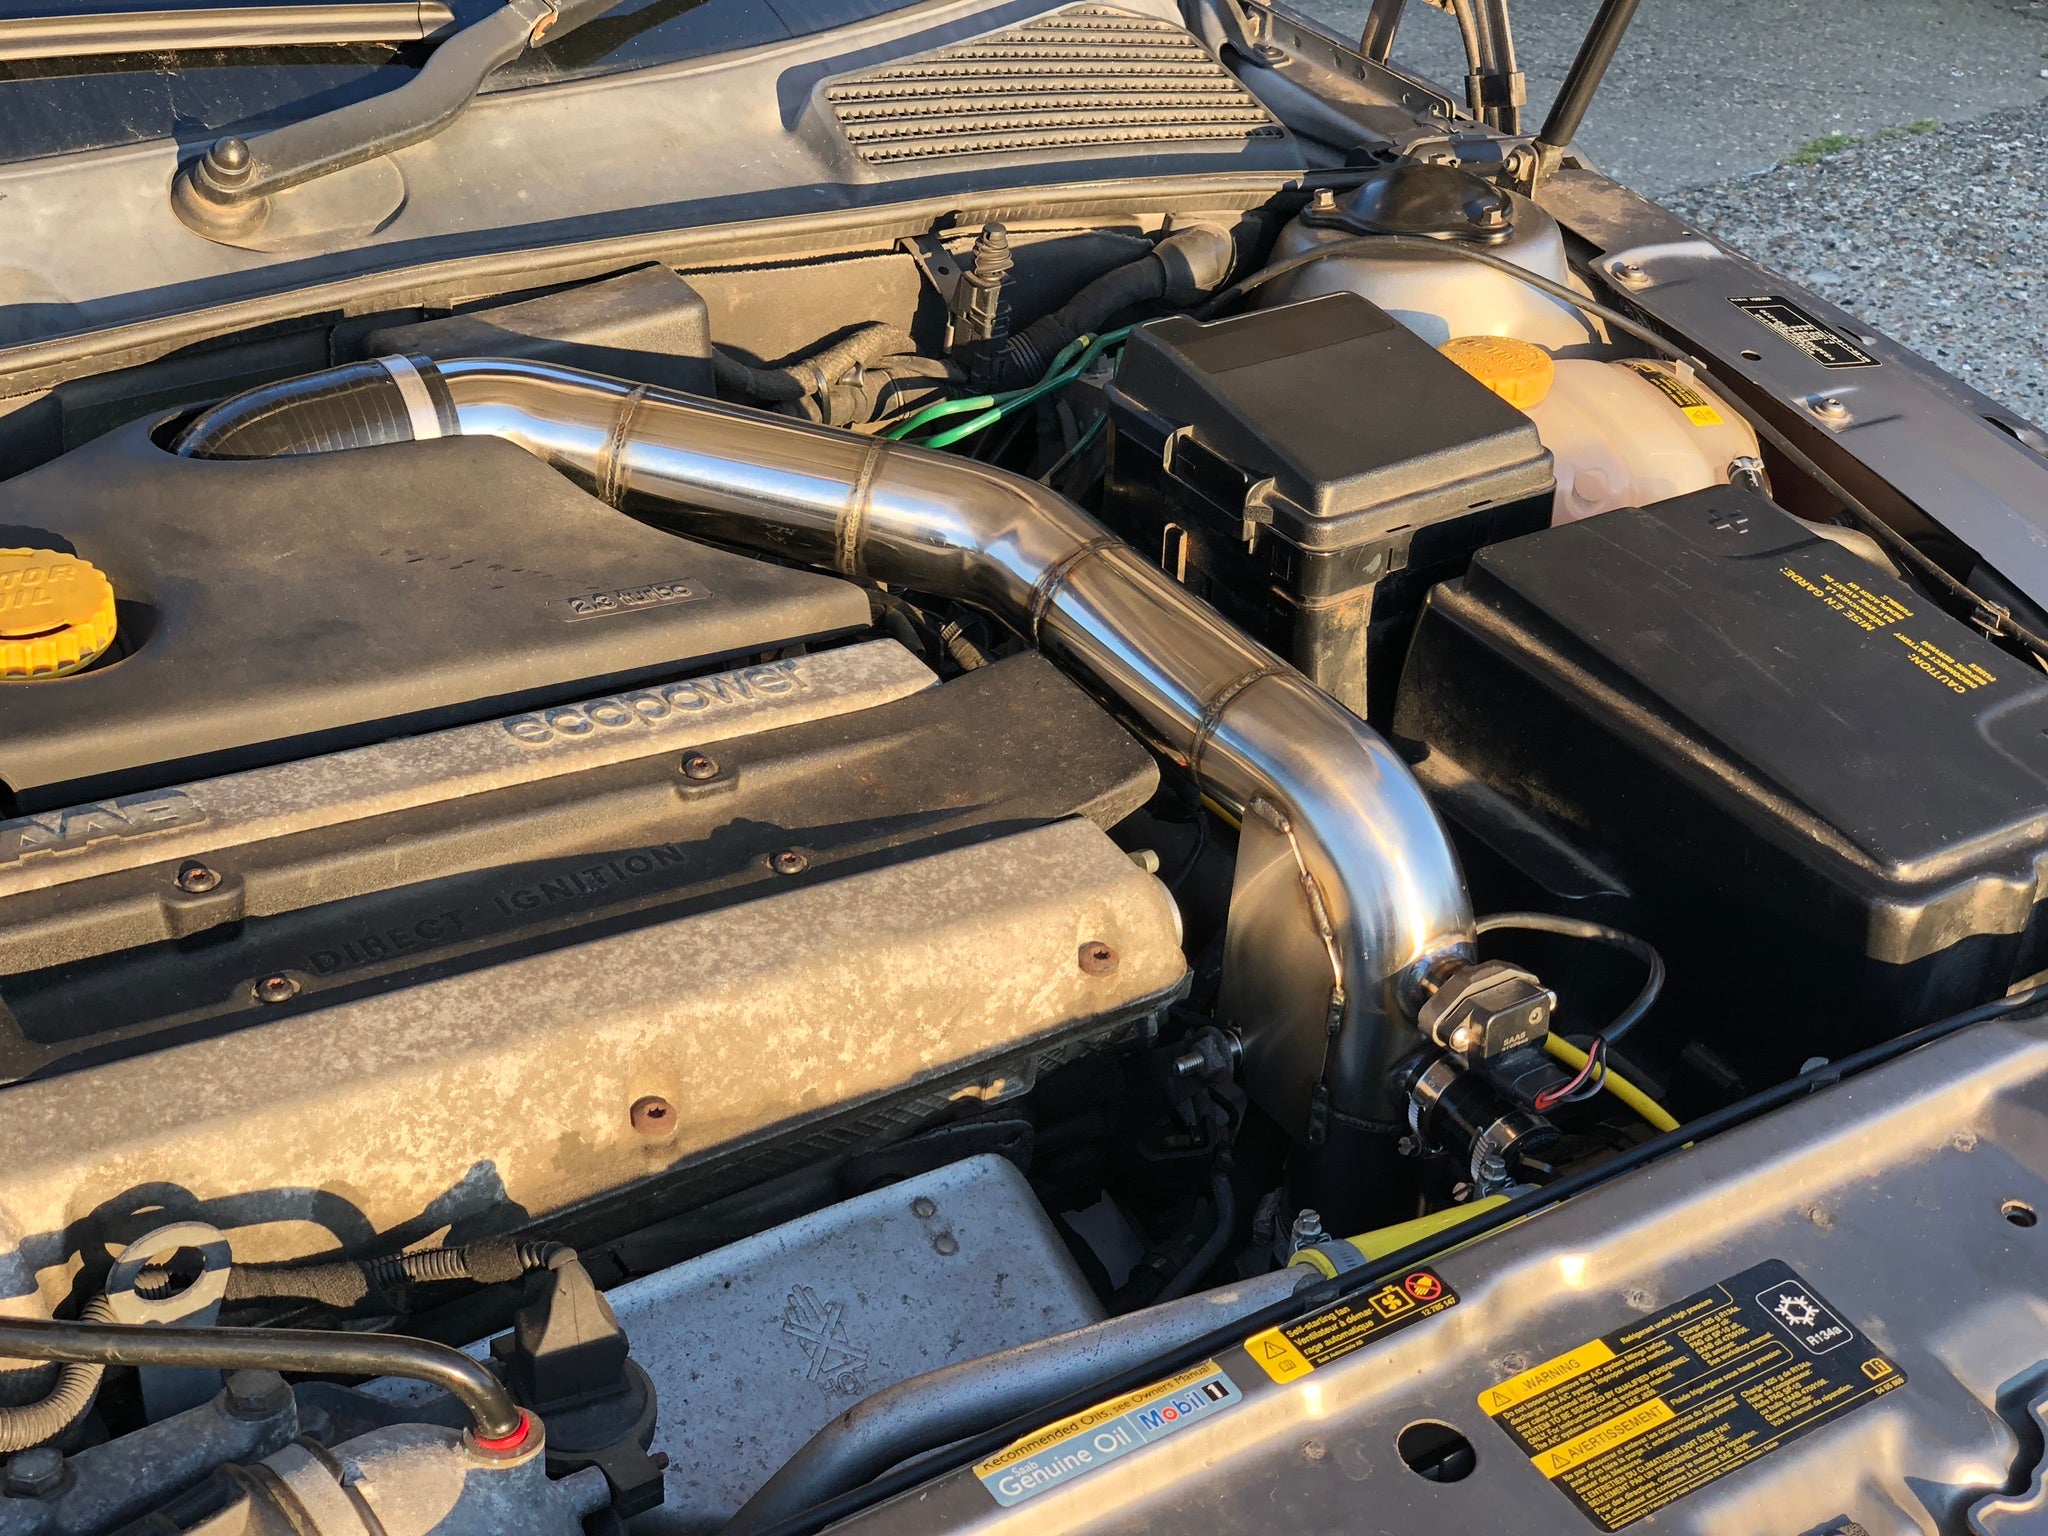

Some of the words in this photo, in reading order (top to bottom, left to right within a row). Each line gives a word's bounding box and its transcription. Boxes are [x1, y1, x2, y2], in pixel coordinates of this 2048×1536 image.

[0, 565, 75, 589] TOR
[1779, 567, 1823, 596] GARDE:
[1825, 585, 1836, 593] LA
[1831, 582, 1859, 598] AVANT
[1823, 597, 1844, 609] EN
[1842, 609, 1874, 630] MISE
[1893, 632, 1930, 656] BATTERY
[1908, 653, 1965, 692] CAUTION:
[502, 658, 812, 746] ecopower
[0, 788, 207, 868] AAB
[309, 907, 468, 975] DIRECT
[494, 841, 687, 915] IGNITION
[1286, 1313, 1336, 1337] Self-starting
[1334, 1306, 1350, 1316] fan
[1686, 1298, 1712, 1314] pressure
[1294, 1323, 1338, 1345] Ventilateur
[1345, 1308, 1374, 1323] démar-
[1303, 1342, 1323, 1355] rage
[1324, 1320, 1373, 1345] automatique
[1806, 1326, 1842, 1345] R134a
[818, 1363, 870, 1401] HOT
[1112, 1400, 1131, 1412] see
[1130, 1381, 1173, 1404] Owners
[1173, 1363, 1210, 1384] Manual
[1523, 1359, 1580, 1389] WARNING
[1137, 1390, 1207, 1432] Mobil
[1502, 1411, 1514, 1419] Do
[1514, 1405, 1526, 1414] not
[1524, 1395, 1548, 1408] loosen
[1555, 1380, 1579, 1394] remove
[1510, 1404, 1548, 1425] discharging
[1546, 1399, 1559, 1407] the
[1521, 1421, 1550, 1438] SYSTEM
[1548, 1416, 1561, 1424] TO
[1559, 1410, 1572, 1419] BE
[1570, 1395, 1605, 1414] SERVICED
[1603, 1389, 1614, 1398] BY
[1614, 1373, 1649, 1393] QUALIFIED
[1532, 1441, 1547, 1450] The
[1546, 1426, 1559, 1435] For
[1568, 1406, 1660, 1457] AVERTISSEMENT
[999, 1450, 1091, 1495] Genuine
[1094, 1426, 1131, 1452] Oil
[1011, 1461, 1038, 1476] Saab
[1587, 1475, 1626, 1497] ENTRETIEN
[1624, 1469, 1637, 1478] DU
[1636, 1447, 1681, 1472] CLIMATISEUR
[1680, 1438, 1697, 1451] DOIT
[1696, 1429, 1716, 1442] ÊTRE
[1714, 1422, 1730, 1434] FAIT
[1588, 1482, 1629, 1507] SEULEMENT
[1629, 1475, 1645, 1486] PAR
[1643, 1469, 1656, 1478] UN
[1654, 1450, 1697, 1472] PERSONNEL
[1593, 1503, 1611, 1514] Pour
[1611, 1496, 1624, 1506] des
